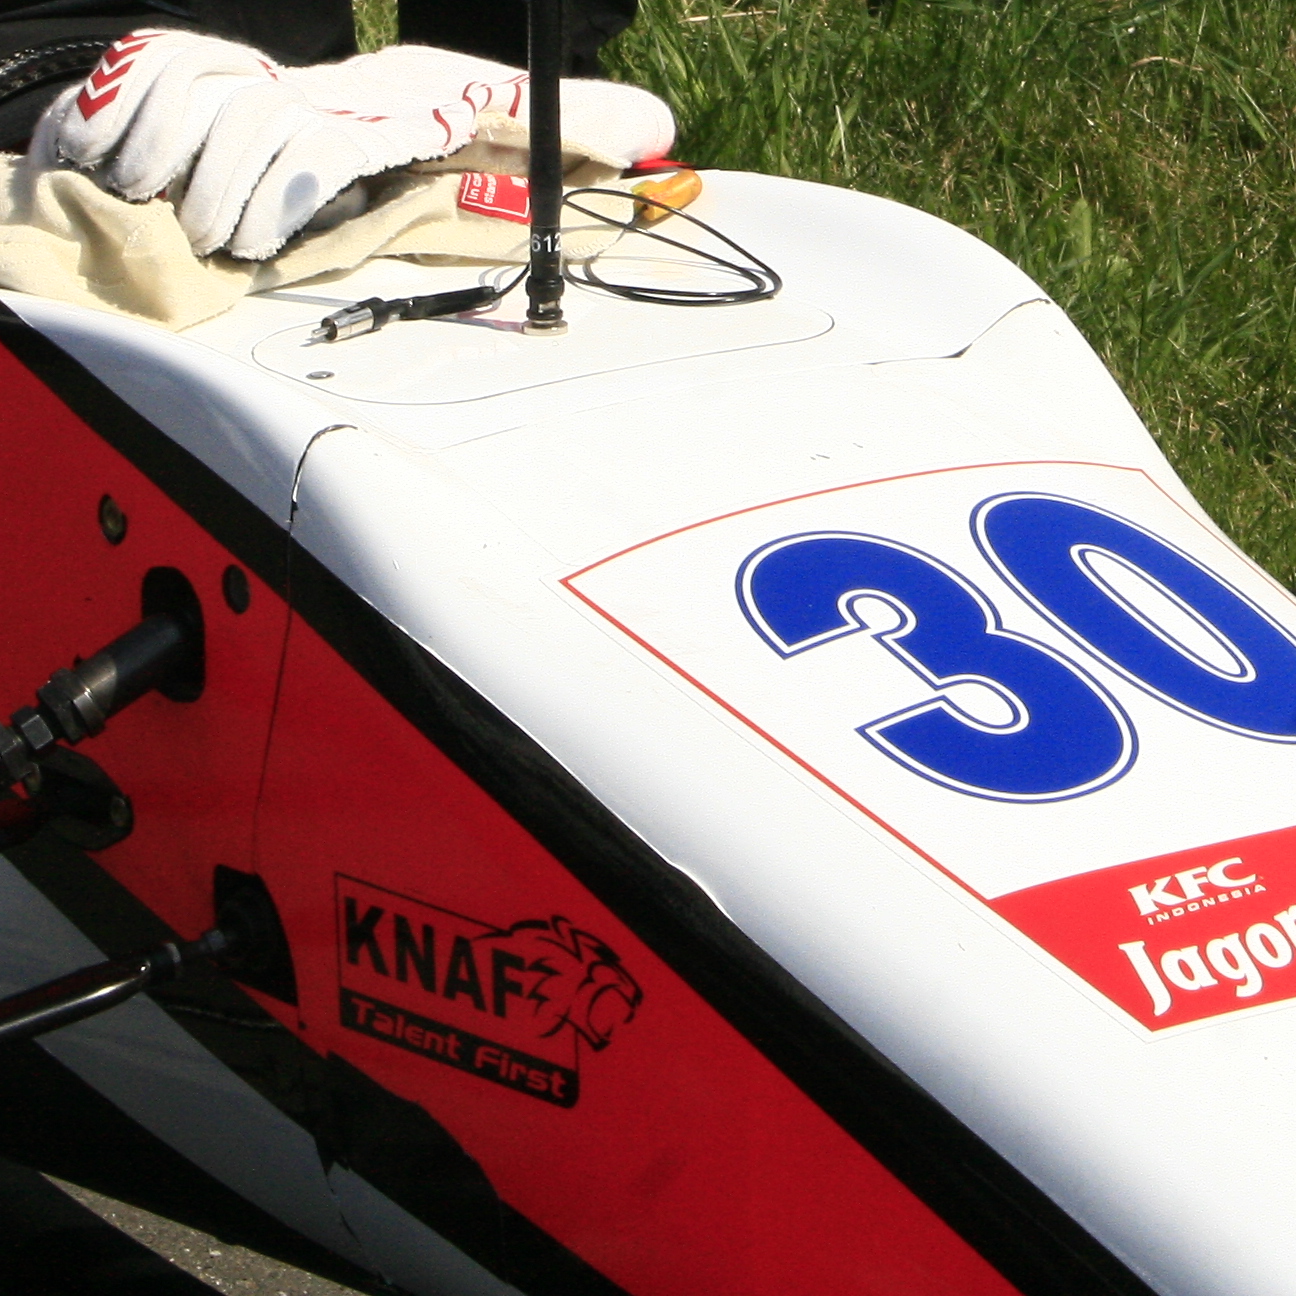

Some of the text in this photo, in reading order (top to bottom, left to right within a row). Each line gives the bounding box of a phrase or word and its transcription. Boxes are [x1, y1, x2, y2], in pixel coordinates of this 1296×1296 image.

[1127, 856, 1257, 917] KFC
[1147, 883, 1267, 926] INDONESIA
[343, 895, 526, 1019] KNAF
[352, 1000, 567, 1099] Talent First
